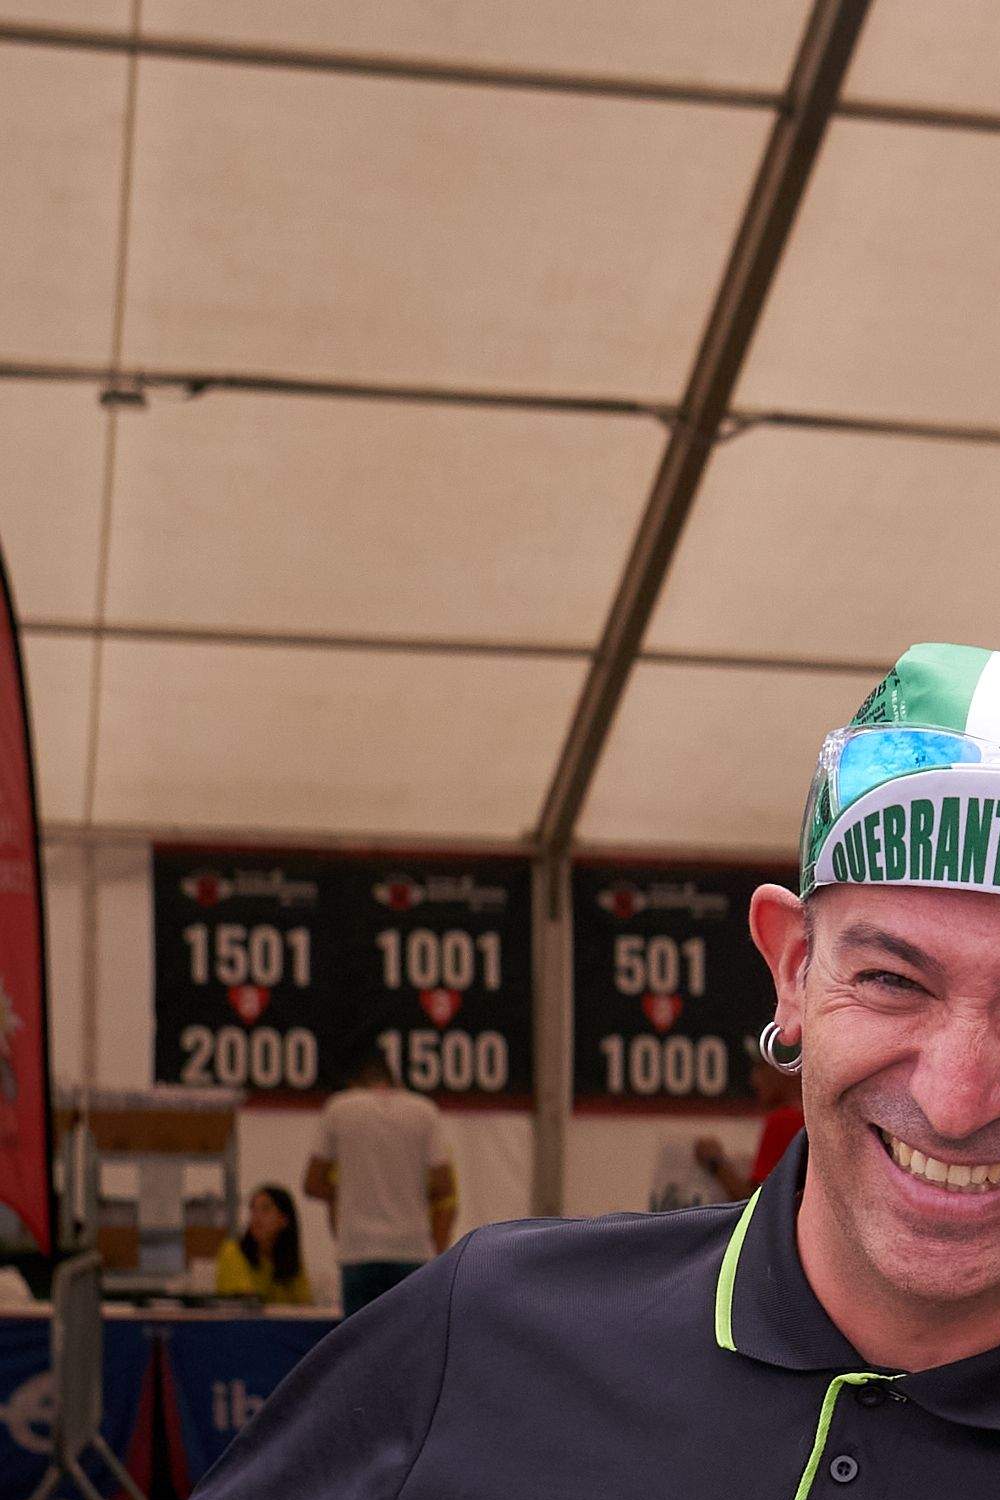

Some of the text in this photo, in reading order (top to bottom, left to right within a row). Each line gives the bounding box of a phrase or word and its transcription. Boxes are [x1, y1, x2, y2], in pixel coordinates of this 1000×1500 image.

[182, 921, 311, 987] 1501
[376, 927, 501, 992] 1001
[614, 934, 705, 998] 501
[180, 1025, 318, 1090] 2000
[377, 1029, 509, 1092] 1500
[600, 1033, 728, 1096] 1000
